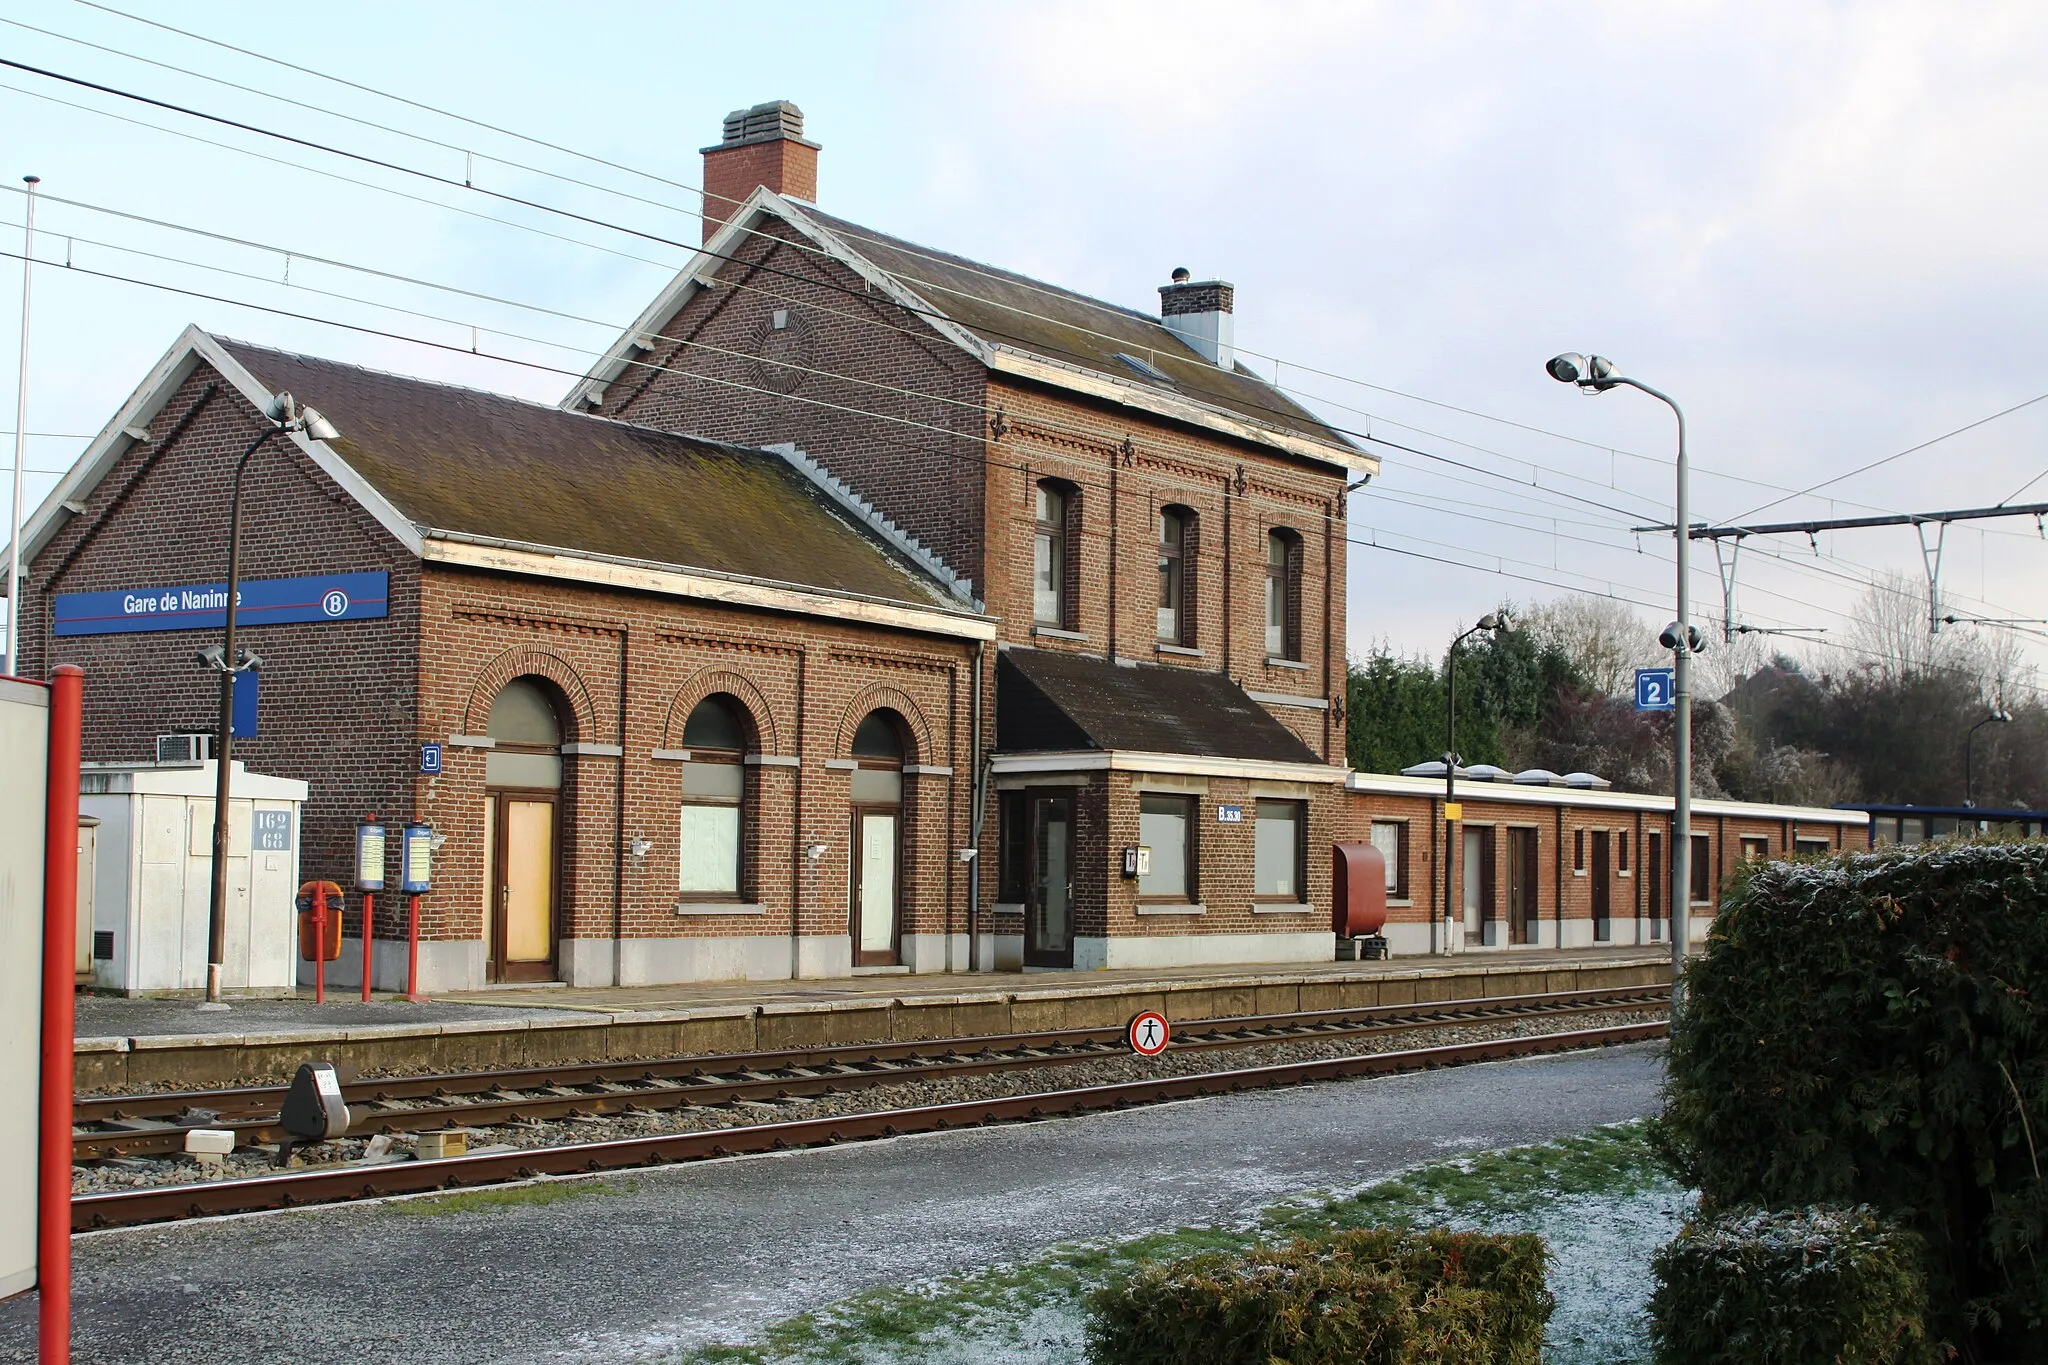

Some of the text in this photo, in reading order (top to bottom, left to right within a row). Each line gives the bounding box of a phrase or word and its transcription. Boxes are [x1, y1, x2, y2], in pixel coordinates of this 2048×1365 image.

[124, 595, 157, 614] Gare
[160, 592, 178, 611] de
[1647, 682, 1661, 702] 2
[259, 813, 286, 829] 162
[262, 832, 283, 849] 68
